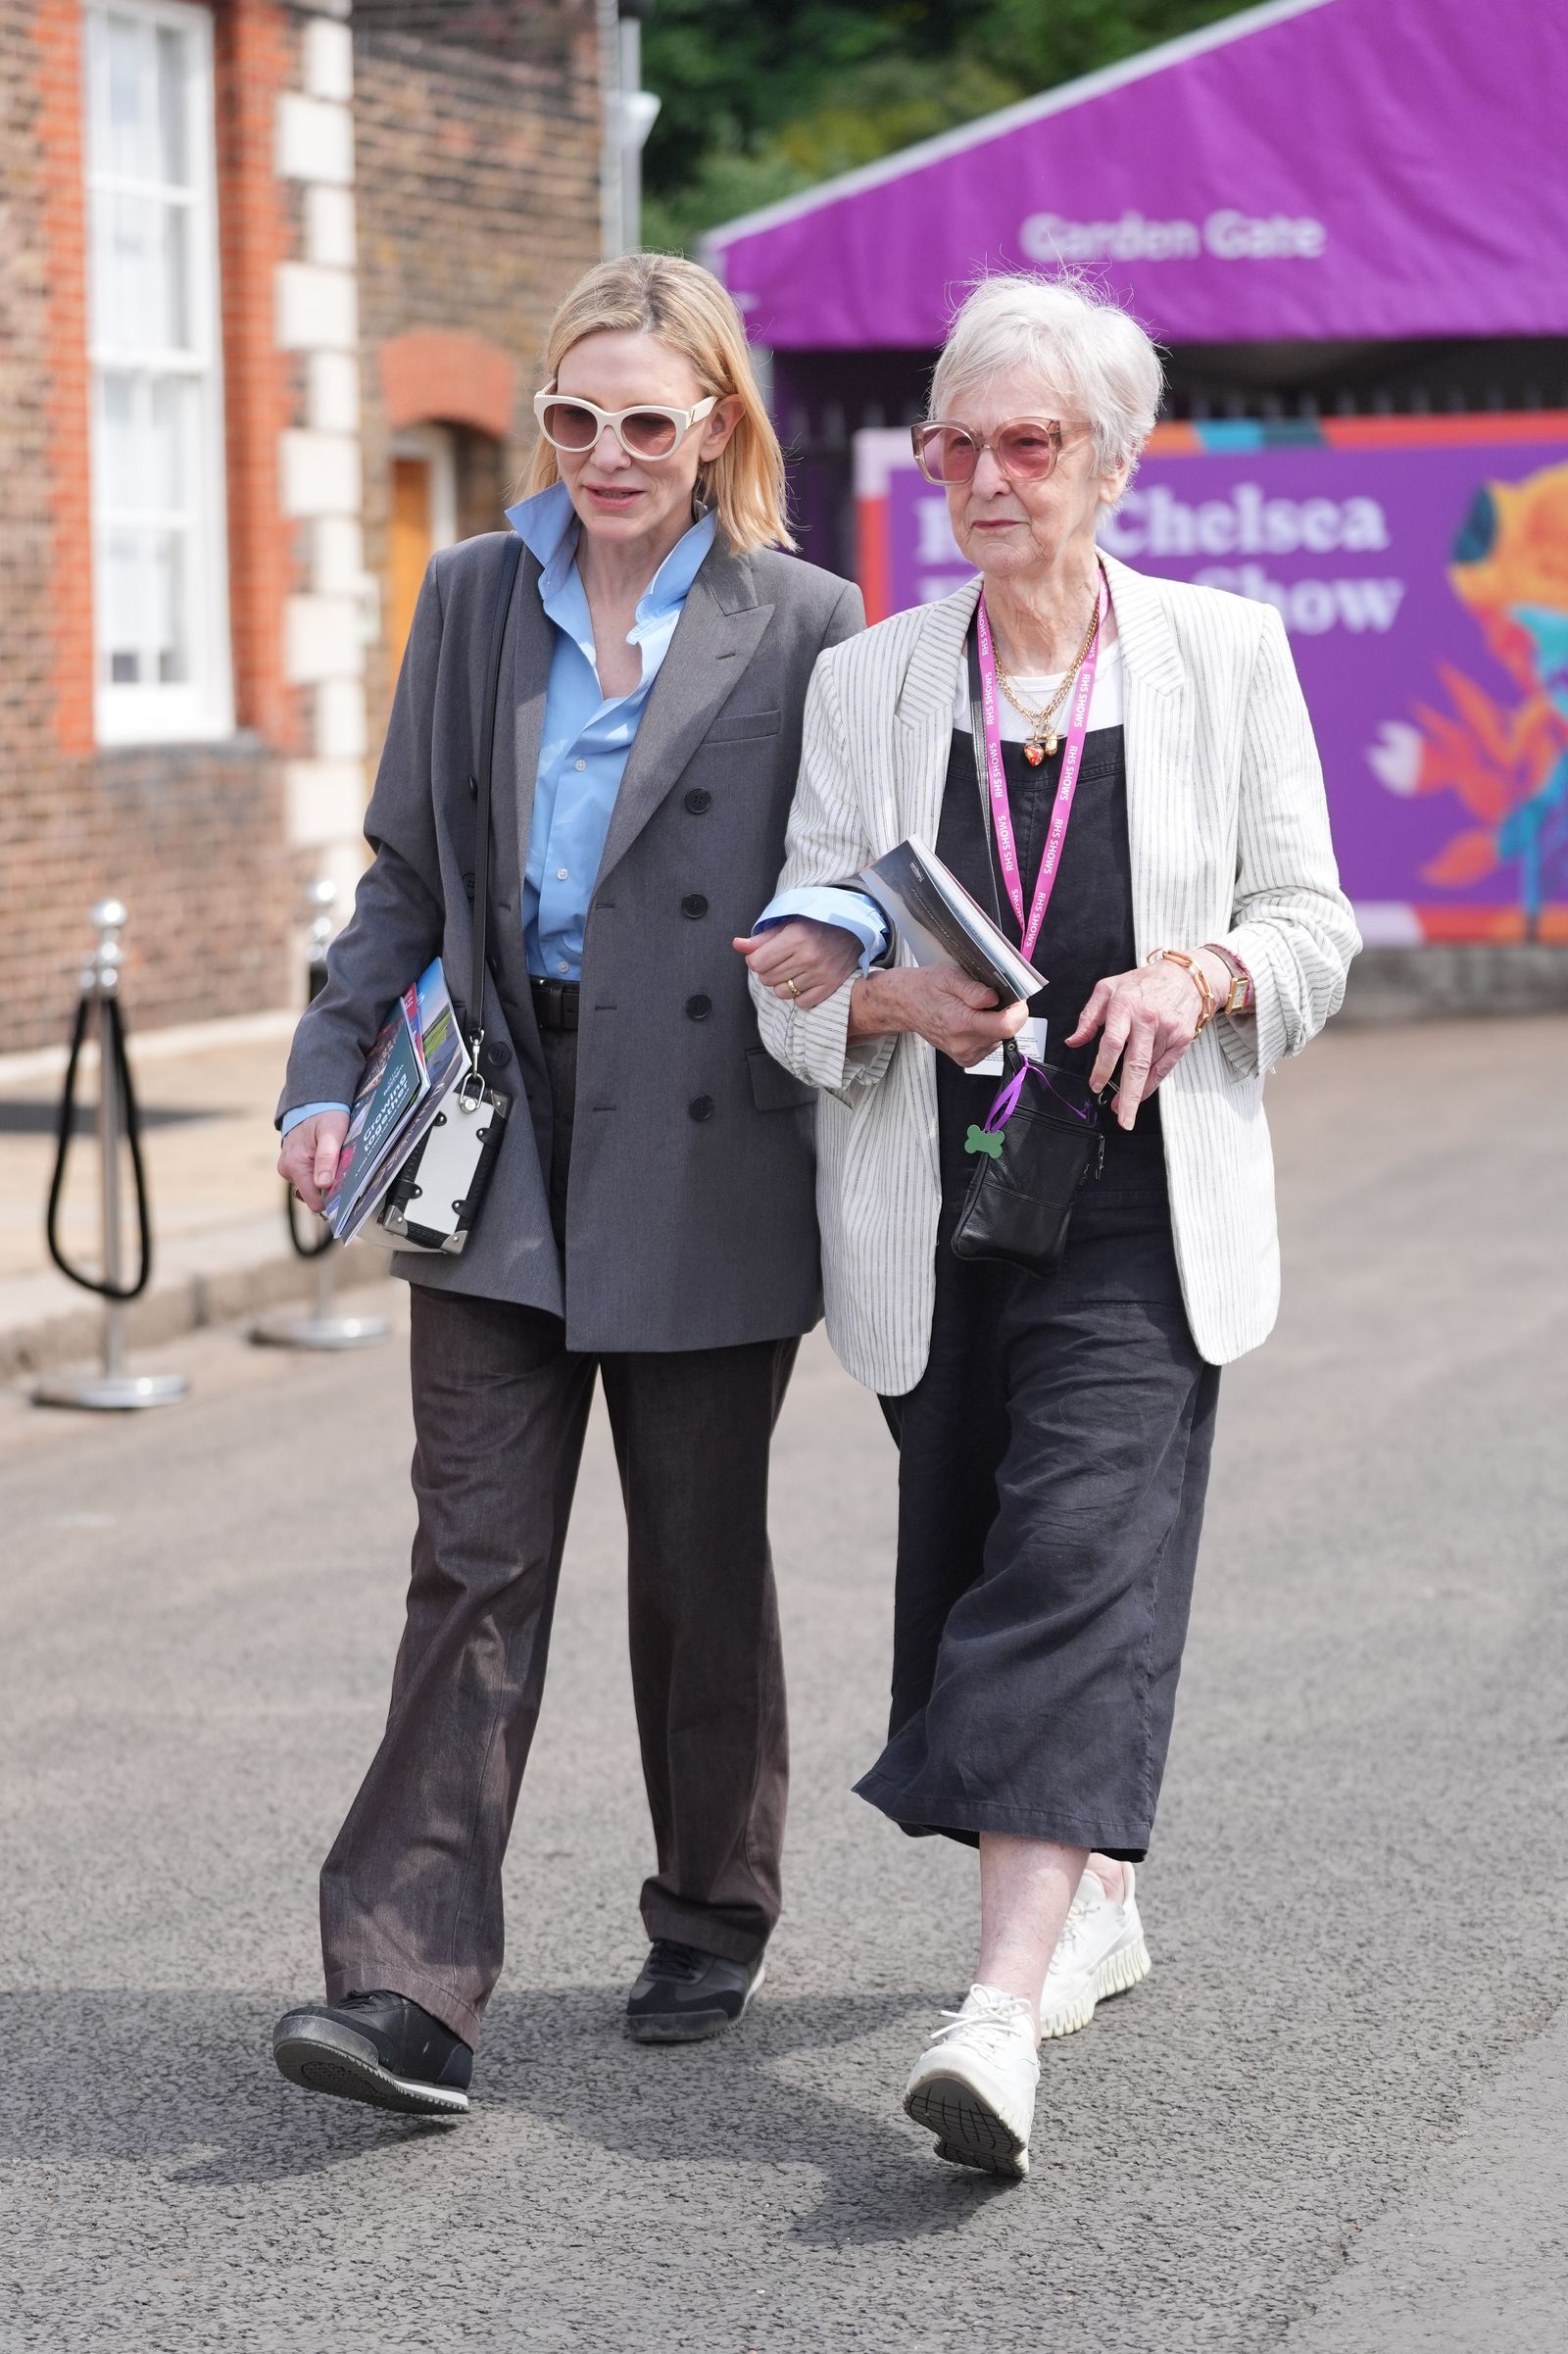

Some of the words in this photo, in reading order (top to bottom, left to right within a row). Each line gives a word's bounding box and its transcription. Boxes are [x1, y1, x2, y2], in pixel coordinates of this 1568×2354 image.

[1021, 209, 1200, 261] Garden
[1204, 208, 1325, 260] Gate
[1100, 482, 1391, 557] Chelsea
[985, 671, 994, 705] SHOWS
[1080, 674, 1091, 693] RHS
[1074, 693, 1088, 728] SHOWS
[989, 742, 1002, 778] SHOWS
[1067, 745, 1079, 765] RHS
[994, 778, 1004, 798] RHS
[1059, 765, 1075, 801] SHOWS
[998, 814, 1011, 851] SHOWS
[1053, 818, 1063, 838] RHS
[1004, 851, 1014, 871] RHS
[1044, 839, 1059, 874] SHOWS
[1035, 892, 1047, 911] RHS
[1026, 911, 1041, 948] SHOWS
[364, 1073, 407, 1142] Growing
[365, 1080, 409, 1152] together
